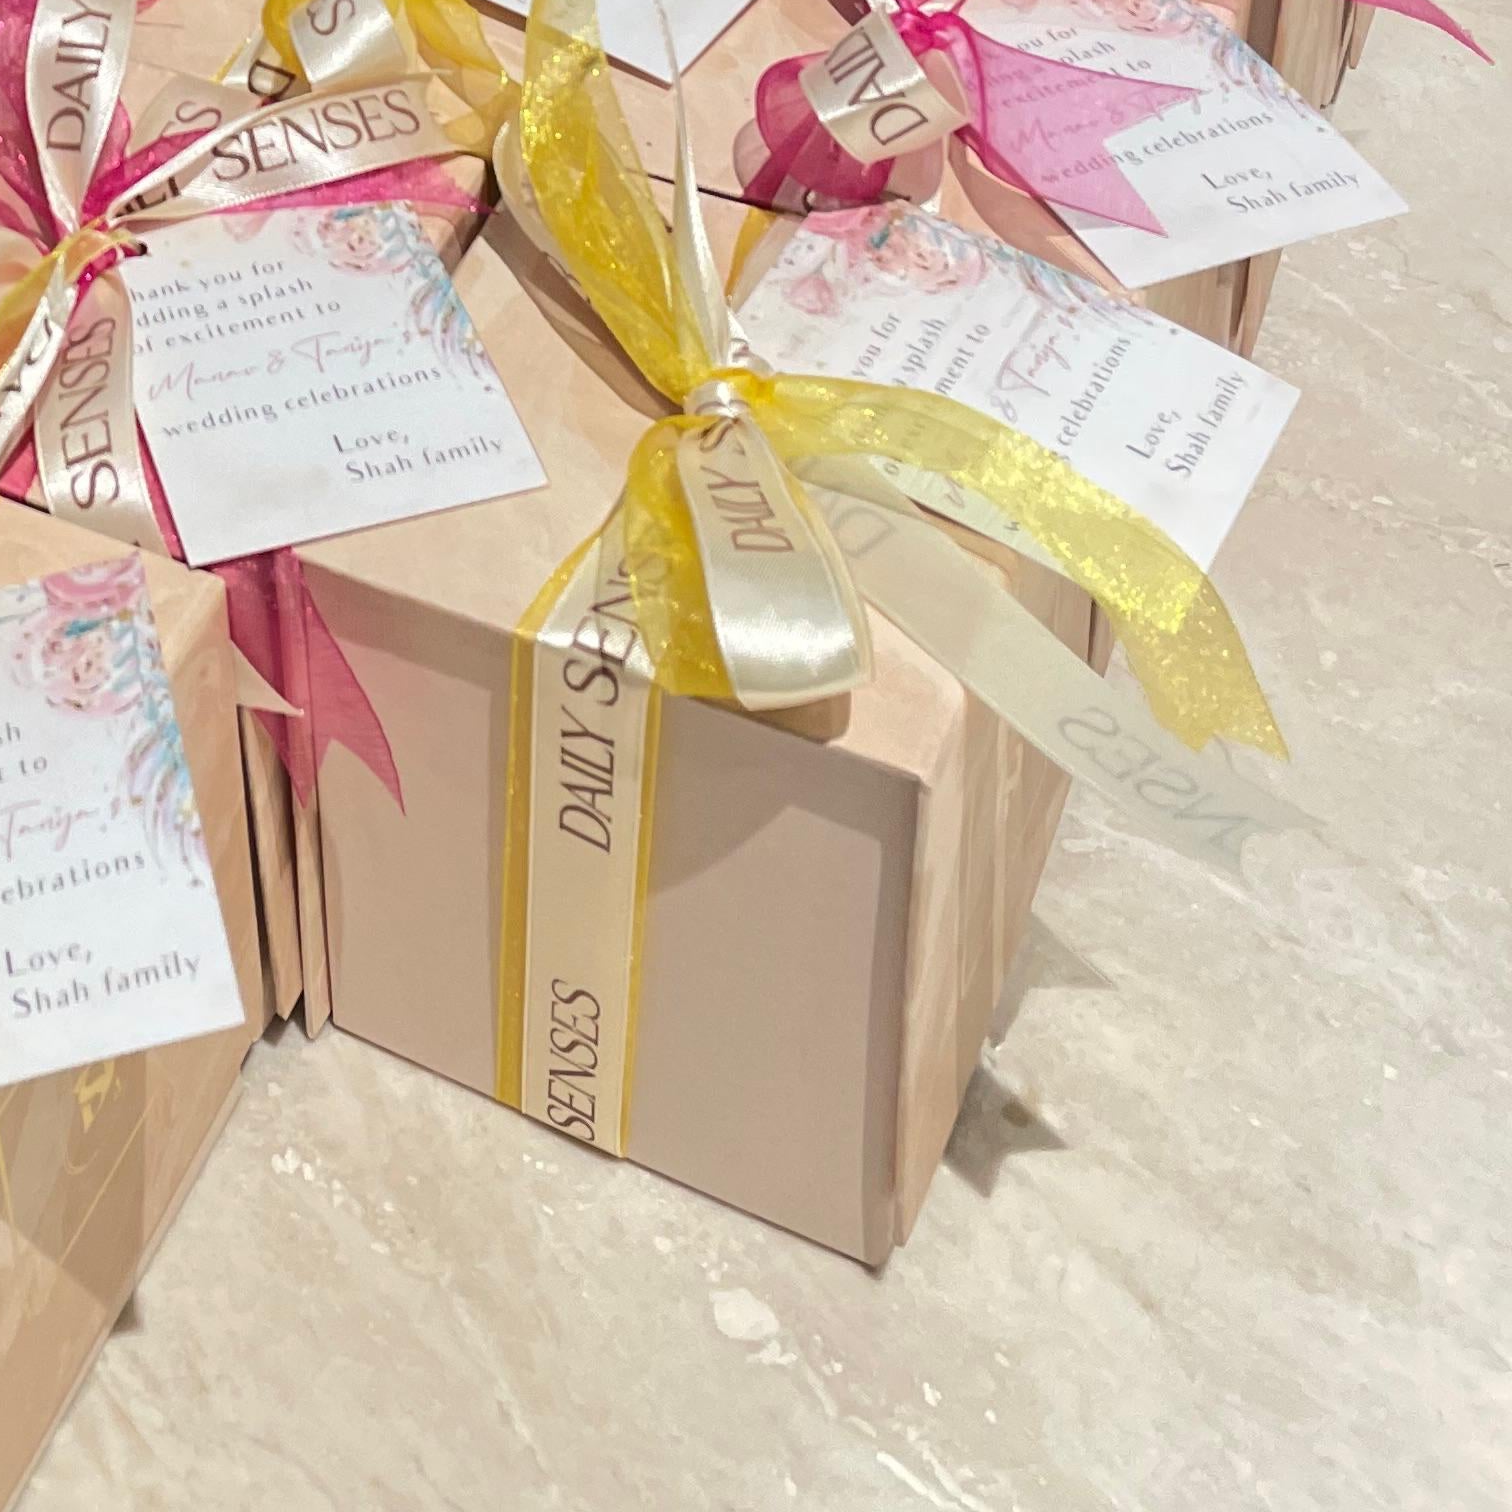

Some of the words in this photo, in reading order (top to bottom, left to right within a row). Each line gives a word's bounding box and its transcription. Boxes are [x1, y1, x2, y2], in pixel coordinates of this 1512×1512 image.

[1046, 26, 1079, 46] for
[1126, 58, 1152, 74] to
[211, 88, 421, 182] SENSES
[1143, 110, 1274, 158] celebrations
[1201, 164, 1273, 192] Love,
[1227, 192, 1289, 215] Shah
[1289, 172, 1362, 200] family
[199, 269, 243, 293] you
[252, 258, 286, 278] for
[238, 278, 314, 310] splash
[165, 311, 305, 351] excitement
[316, 300, 341, 315] to
[852, 343, 882, 379] you
[870, 312, 903, 342] for
[903, 316, 948, 380] splash
[966, 323, 992, 345] to
[60, 316, 118, 510] SENSES
[162, 401, 277, 440] wedding
[284, 365, 443, 414] celebrations
[1058, 333, 1133, 448] celebrations
[333, 425, 411, 457] Love,
[1126, 408, 1181, 462] Love,
[1167, 428, 1210, 478] Shah
[1199, 370, 1248, 434] family
[344, 454, 415, 484] Shah
[421, 435, 505, 468] family
[20, 753, 49, 776] to
[559, 706, 616, 855] DAILY
[4, 936, 92, 978] Love,
[12, 978, 90, 1020] Shah
[103, 950, 200, 997] family
[546, 977, 603, 1143] SENSES
